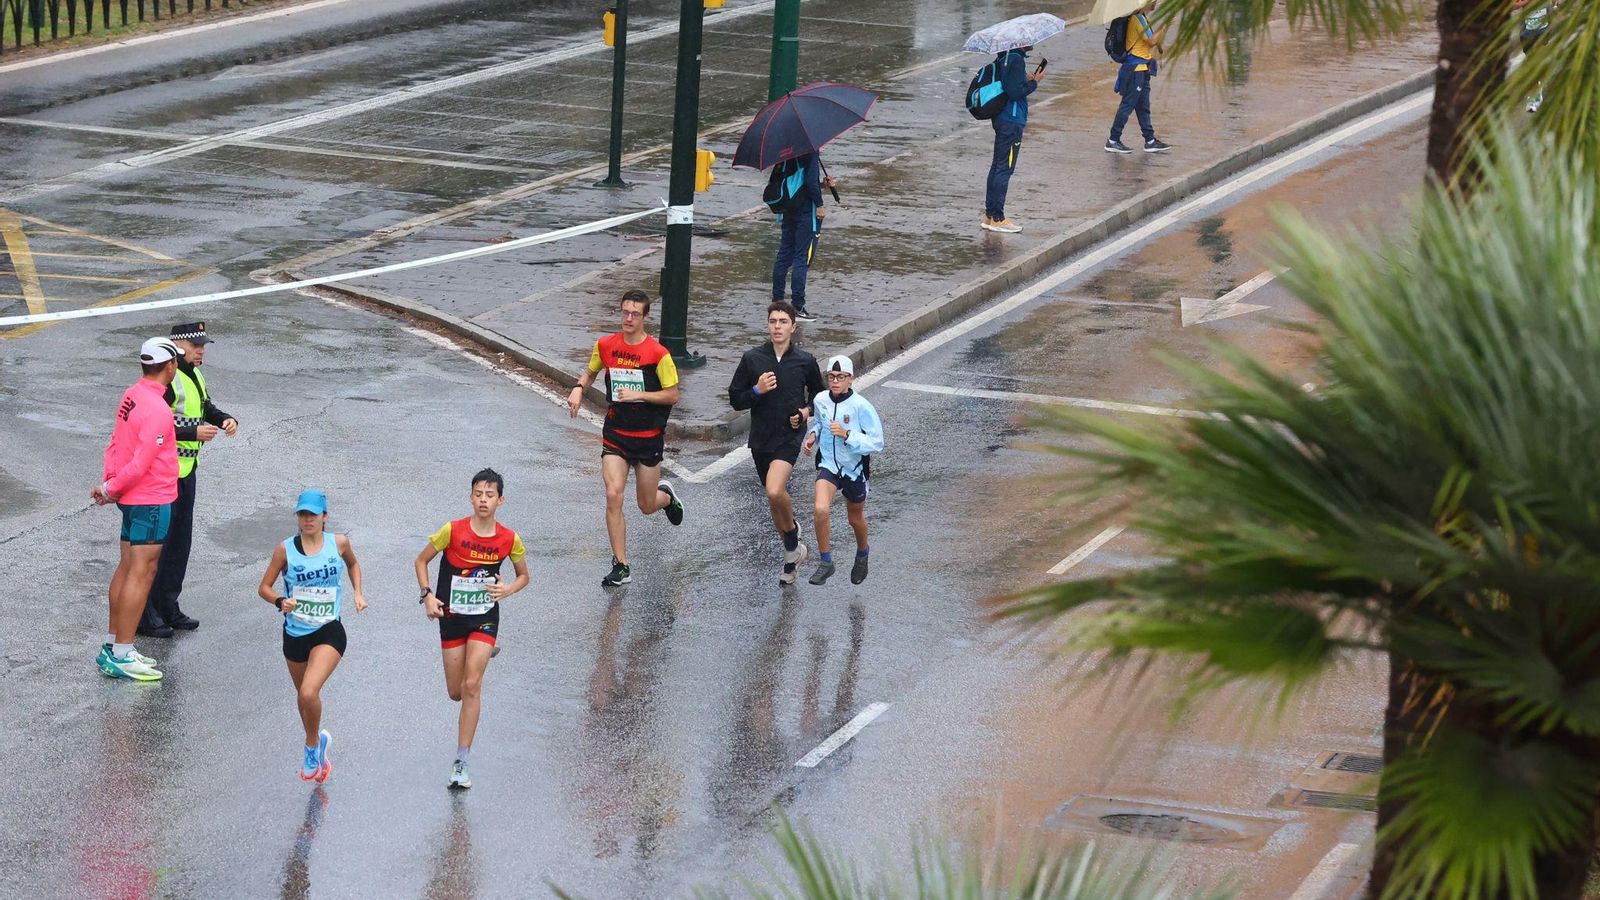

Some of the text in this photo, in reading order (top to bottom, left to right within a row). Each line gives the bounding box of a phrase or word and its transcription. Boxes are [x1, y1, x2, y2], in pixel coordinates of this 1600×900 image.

[296, 564, 338, 582] nerja
[454, 592, 491, 604] 21446
[295, 602, 333, 616] 20402
